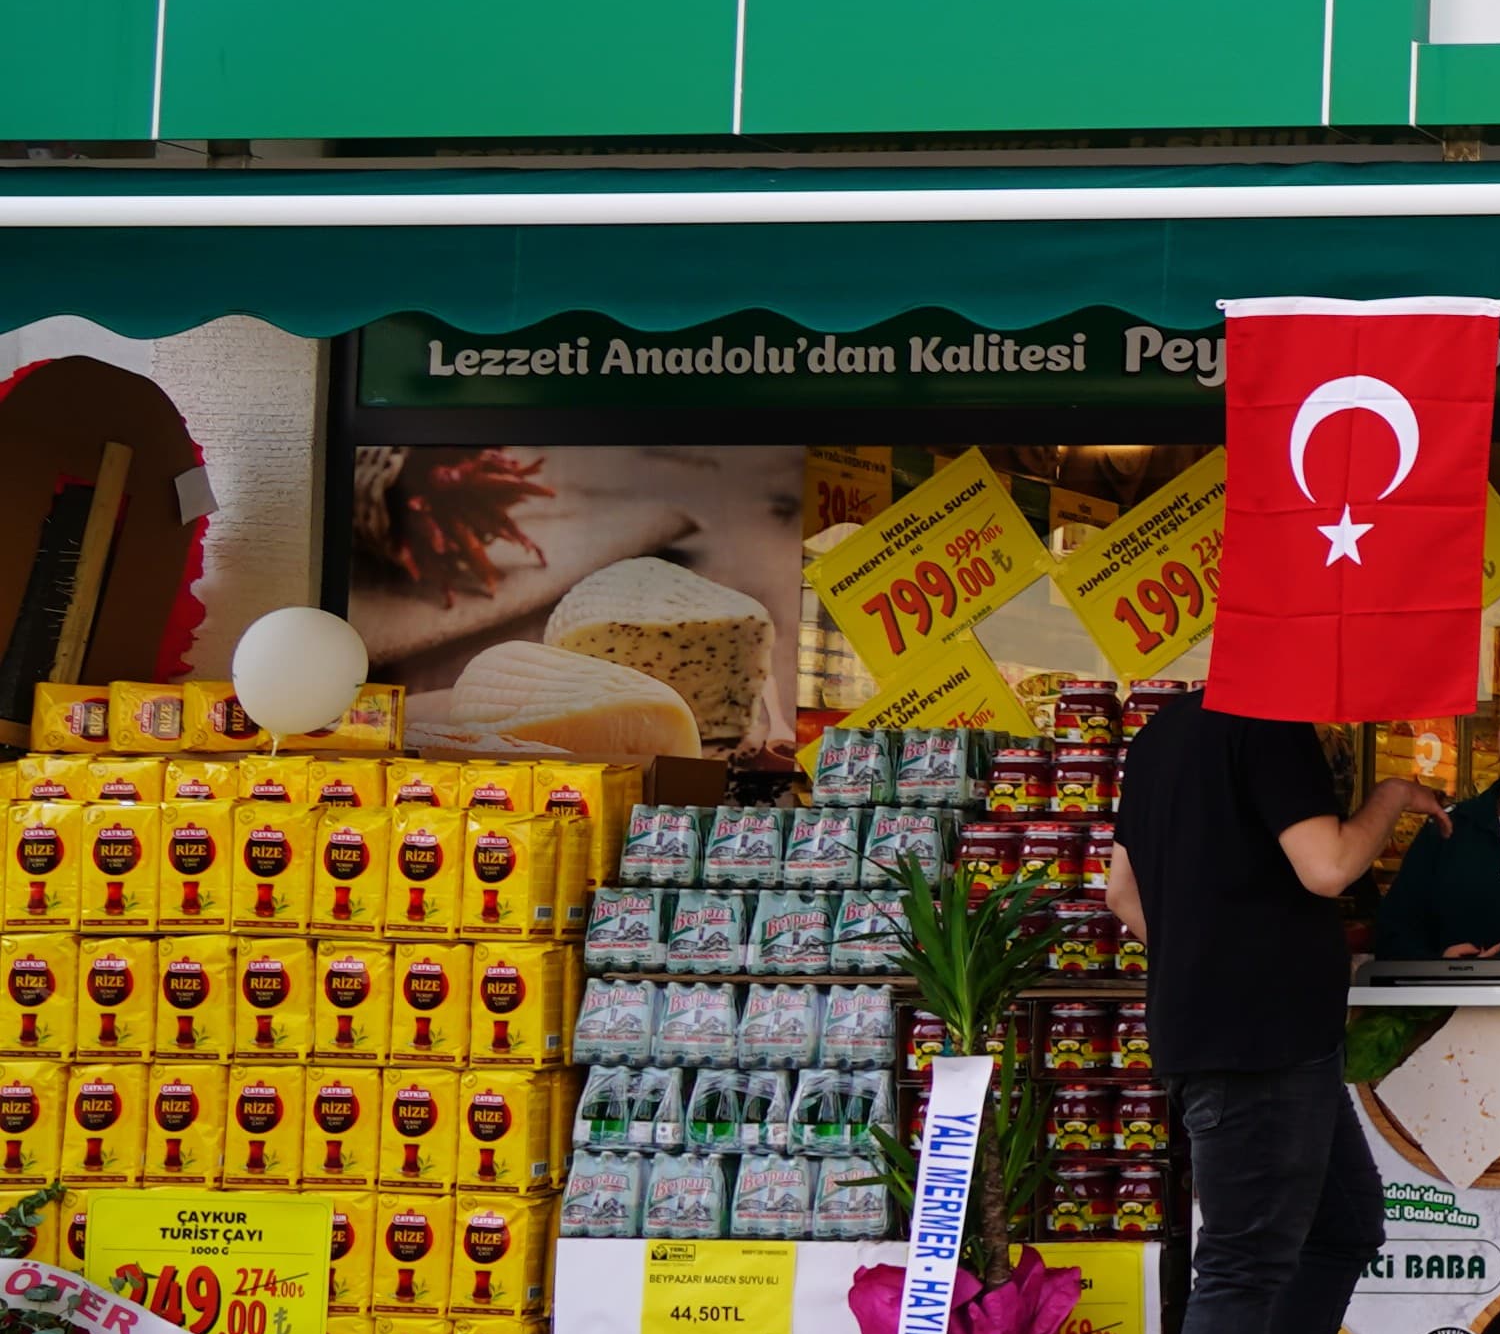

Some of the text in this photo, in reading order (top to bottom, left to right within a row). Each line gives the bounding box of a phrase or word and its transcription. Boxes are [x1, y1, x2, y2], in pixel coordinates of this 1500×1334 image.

[429, 336, 589, 376] Lezzeti
[601, 335, 896, 375] Anadolu'dan
[909, 333, 1087, 373] Kalitesi
[831, 479, 987, 597] FERMENTE KANGAL SUCUK
[881, 512, 921, 543] İKBAL
[1102, 492, 1192, 560] YÖRE EDREMİT
[1076, 561, 1121, 598] JUMBO
[1120, 538, 1155, 567] ÇİZİK
[1151, 514, 1189, 545] YEŞİL
[918, 666, 972, 708] PEYNİRİ
[24, 843, 361, 862] RİZE RİZE RİZE RİZE RİZE
[928, 1113, 978, 1157] YALI
[177, 1211, 247, 1226] ÇAYKUR
[914, 1166, 966, 1262] MERMER
[160, 1226, 263, 1244] TURİST ÇAYI
[190, 1246, 219, 1255] 1000
[649, 1274, 764, 1285] BEYPAZARI MADEN SUYU
[1406, 1255, 1486, 1279] BABA
[670, 1306, 745, 1324] 44,50TL
